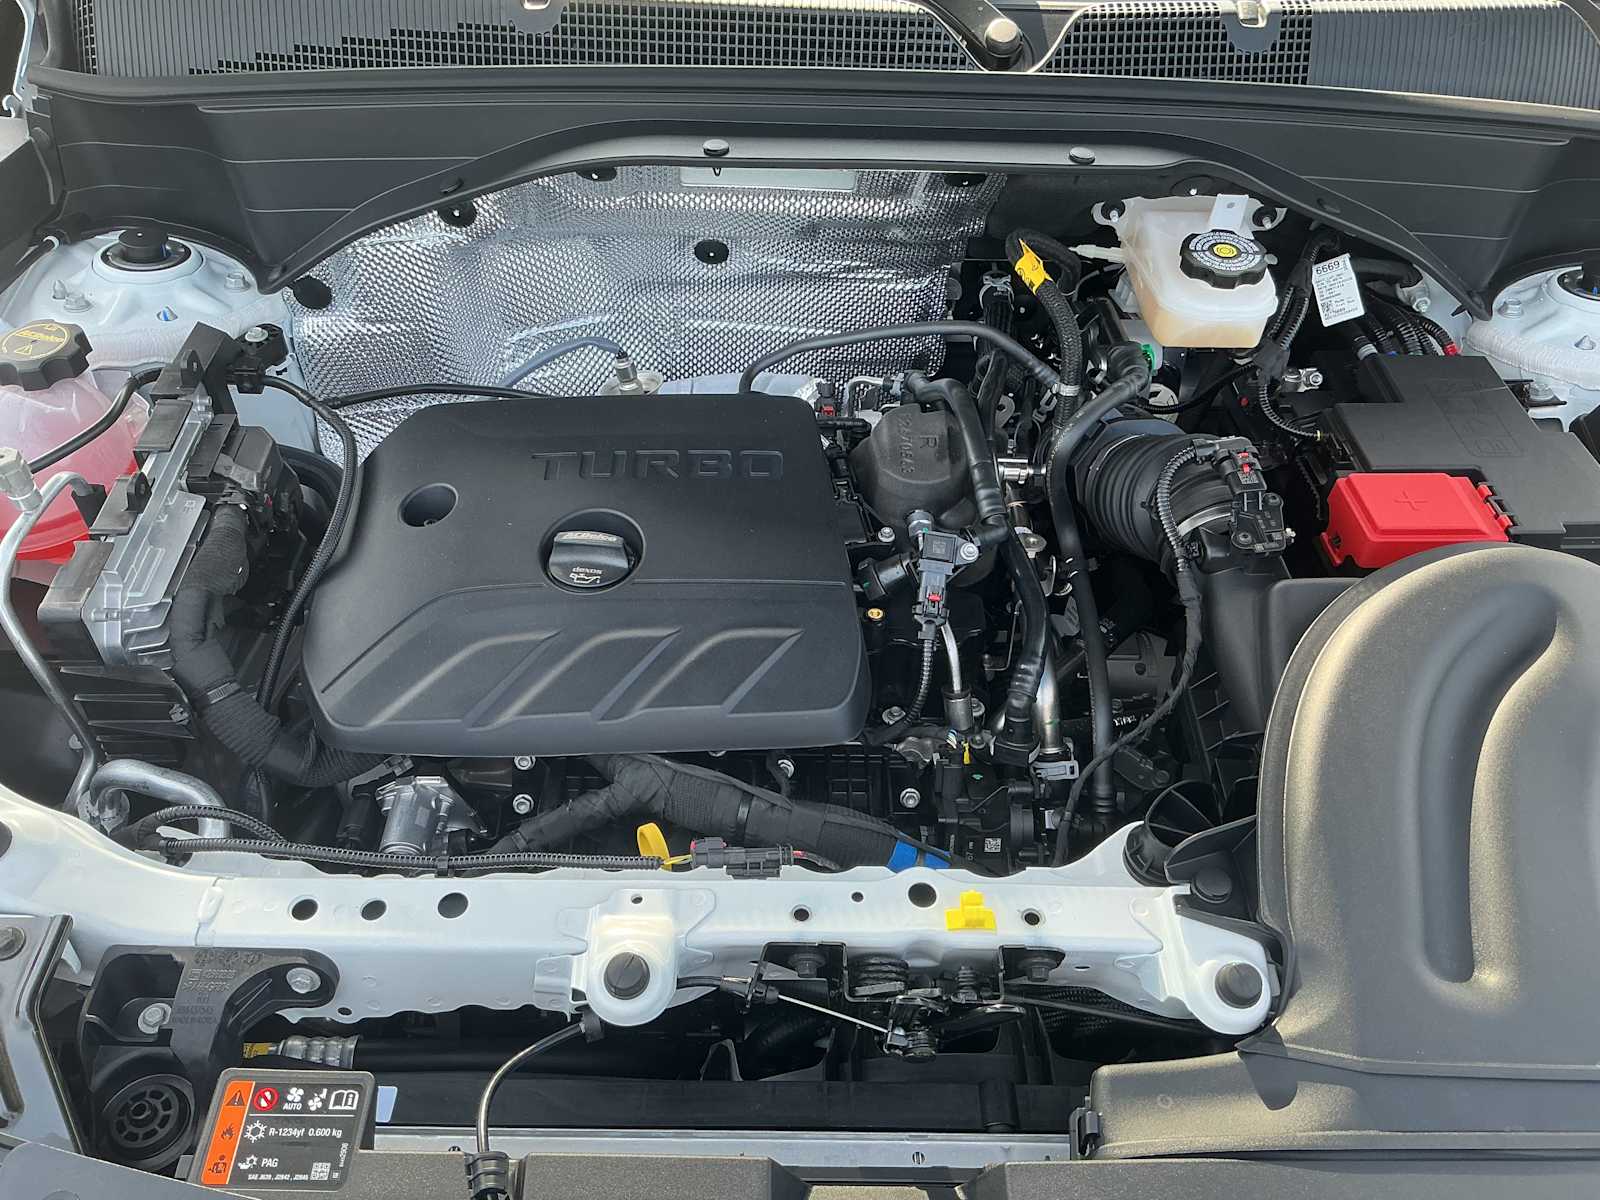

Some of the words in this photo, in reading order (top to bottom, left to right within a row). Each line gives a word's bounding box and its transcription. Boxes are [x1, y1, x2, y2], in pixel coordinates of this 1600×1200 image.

[1316, 261, 1340, 275] 6669
[532, 450, 783, 480] TURBO
[572, 567, 603, 575] dexos
[269, 1128, 304, 1137] R-1234yf
[308, 1128, 330, 1136] 0.600
[332, 1128, 342, 1137] kg
[261, 1158, 279, 1167] PAG
